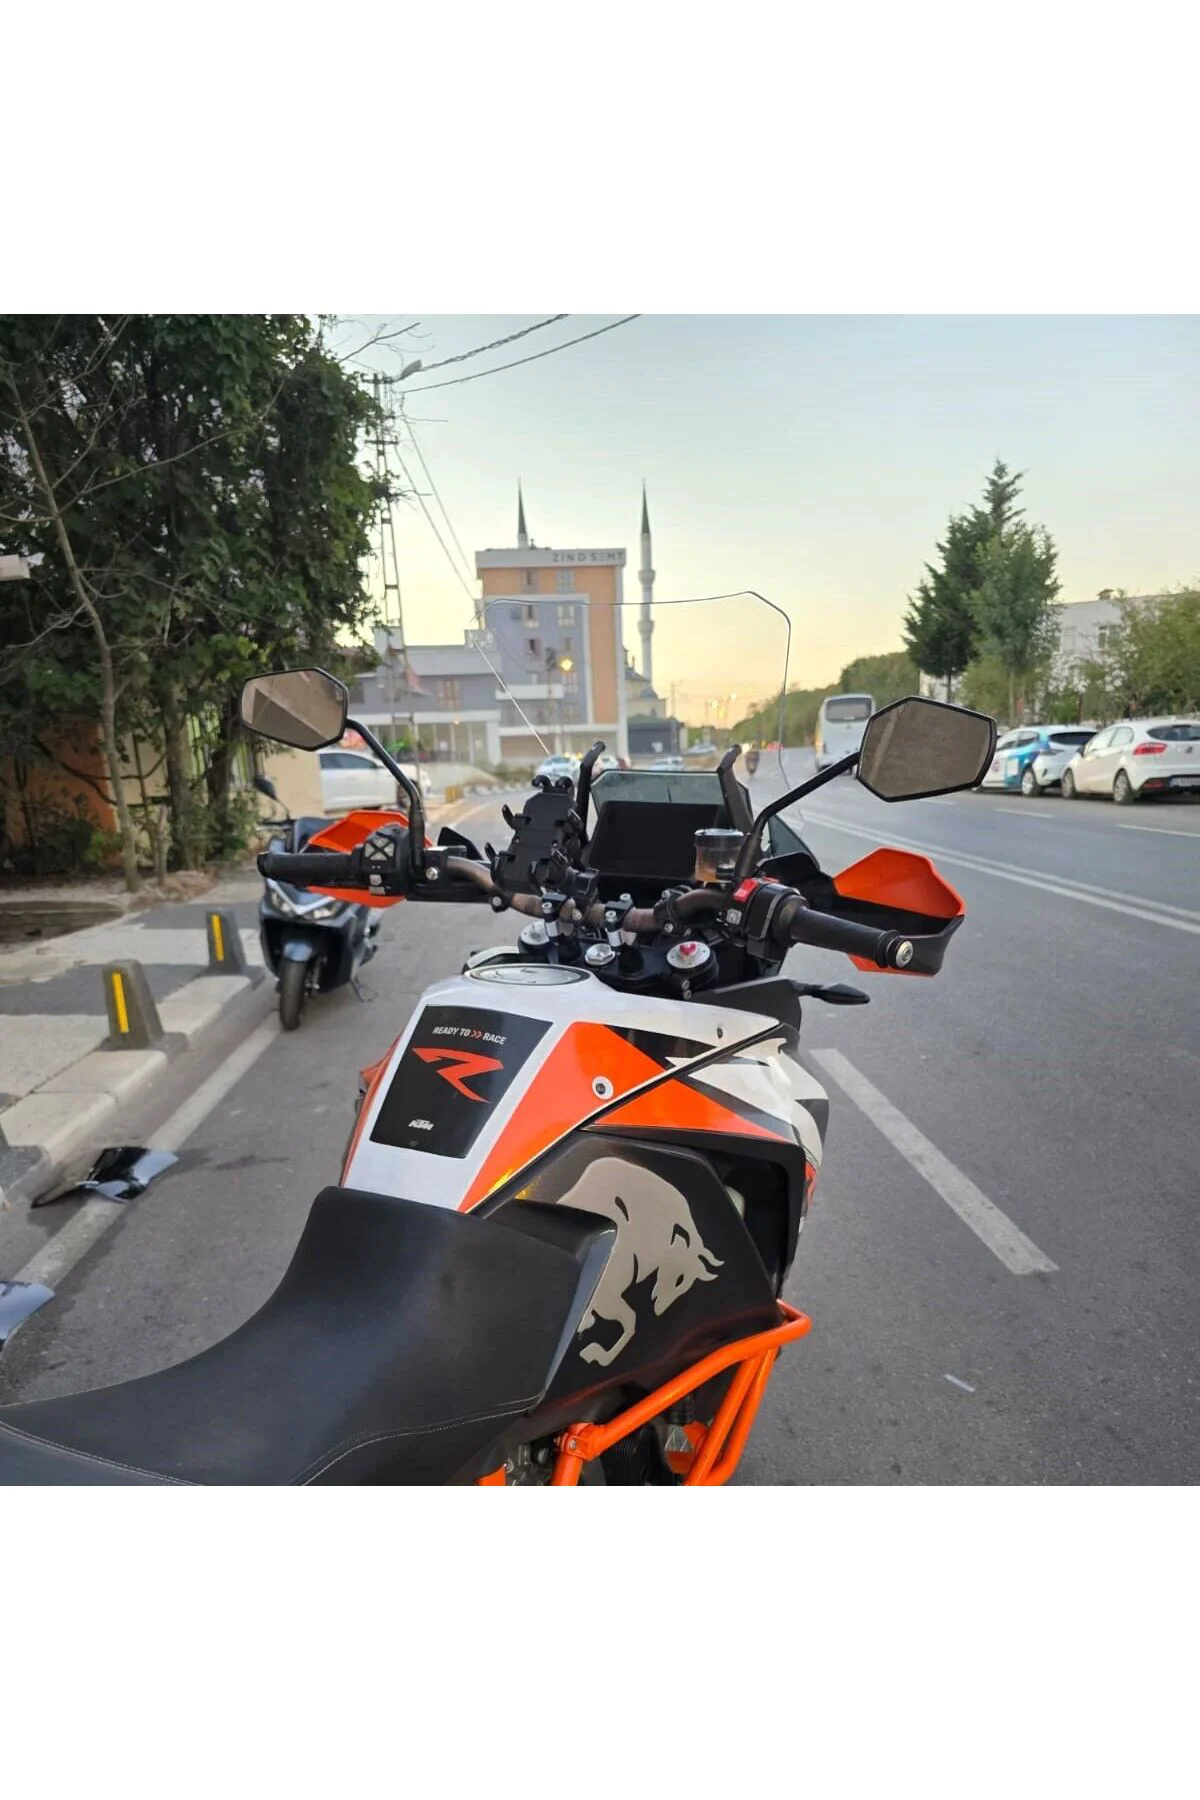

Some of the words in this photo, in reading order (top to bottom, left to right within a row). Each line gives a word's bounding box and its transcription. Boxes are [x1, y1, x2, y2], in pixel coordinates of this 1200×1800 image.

[432, 1027, 459, 1036] READY
[459, 1028, 470, 1037] TO
[482, 1033, 506, 1045] RACE
[408, 1118, 434, 1131] KTM
